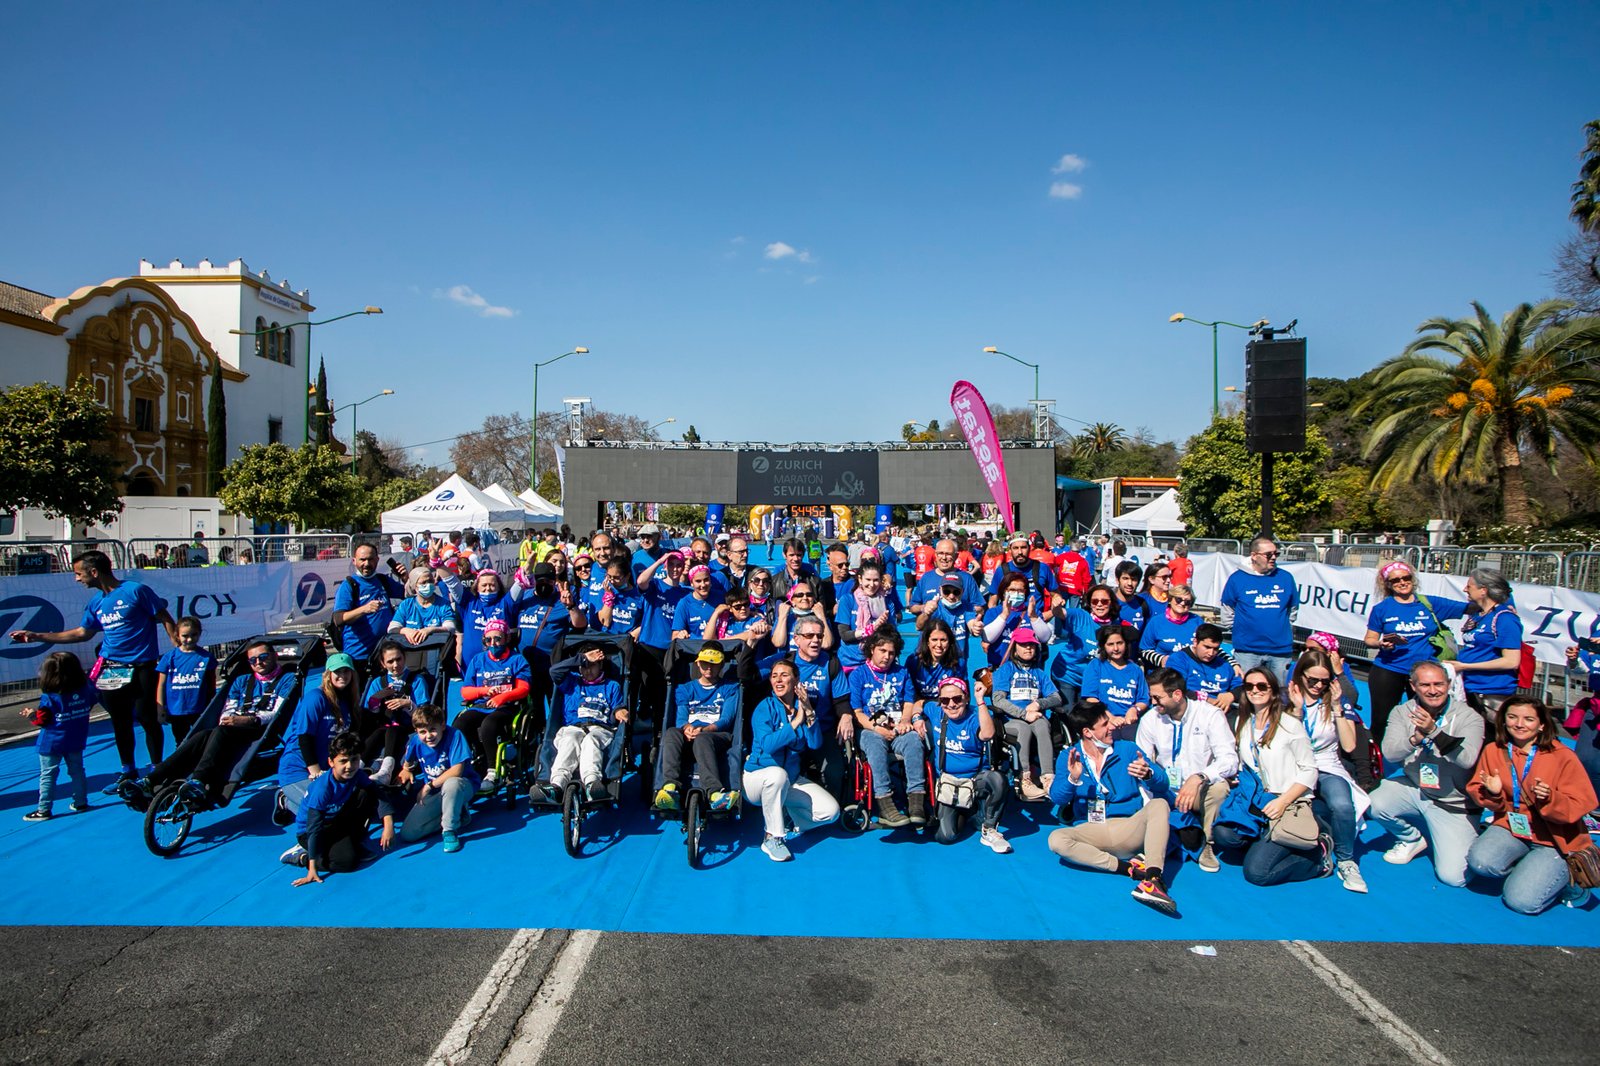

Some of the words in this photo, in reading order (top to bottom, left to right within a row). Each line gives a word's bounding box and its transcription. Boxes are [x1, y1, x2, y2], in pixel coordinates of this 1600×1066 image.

[775, 460, 823, 470] ZURICH
[773, 486, 824, 496] SEVILLA
[412, 504, 465, 512] ZURICH
[23, 557, 43, 566] AMS
[1298, 583, 1371, 616] URICH
[176, 593, 237, 621] ICH
